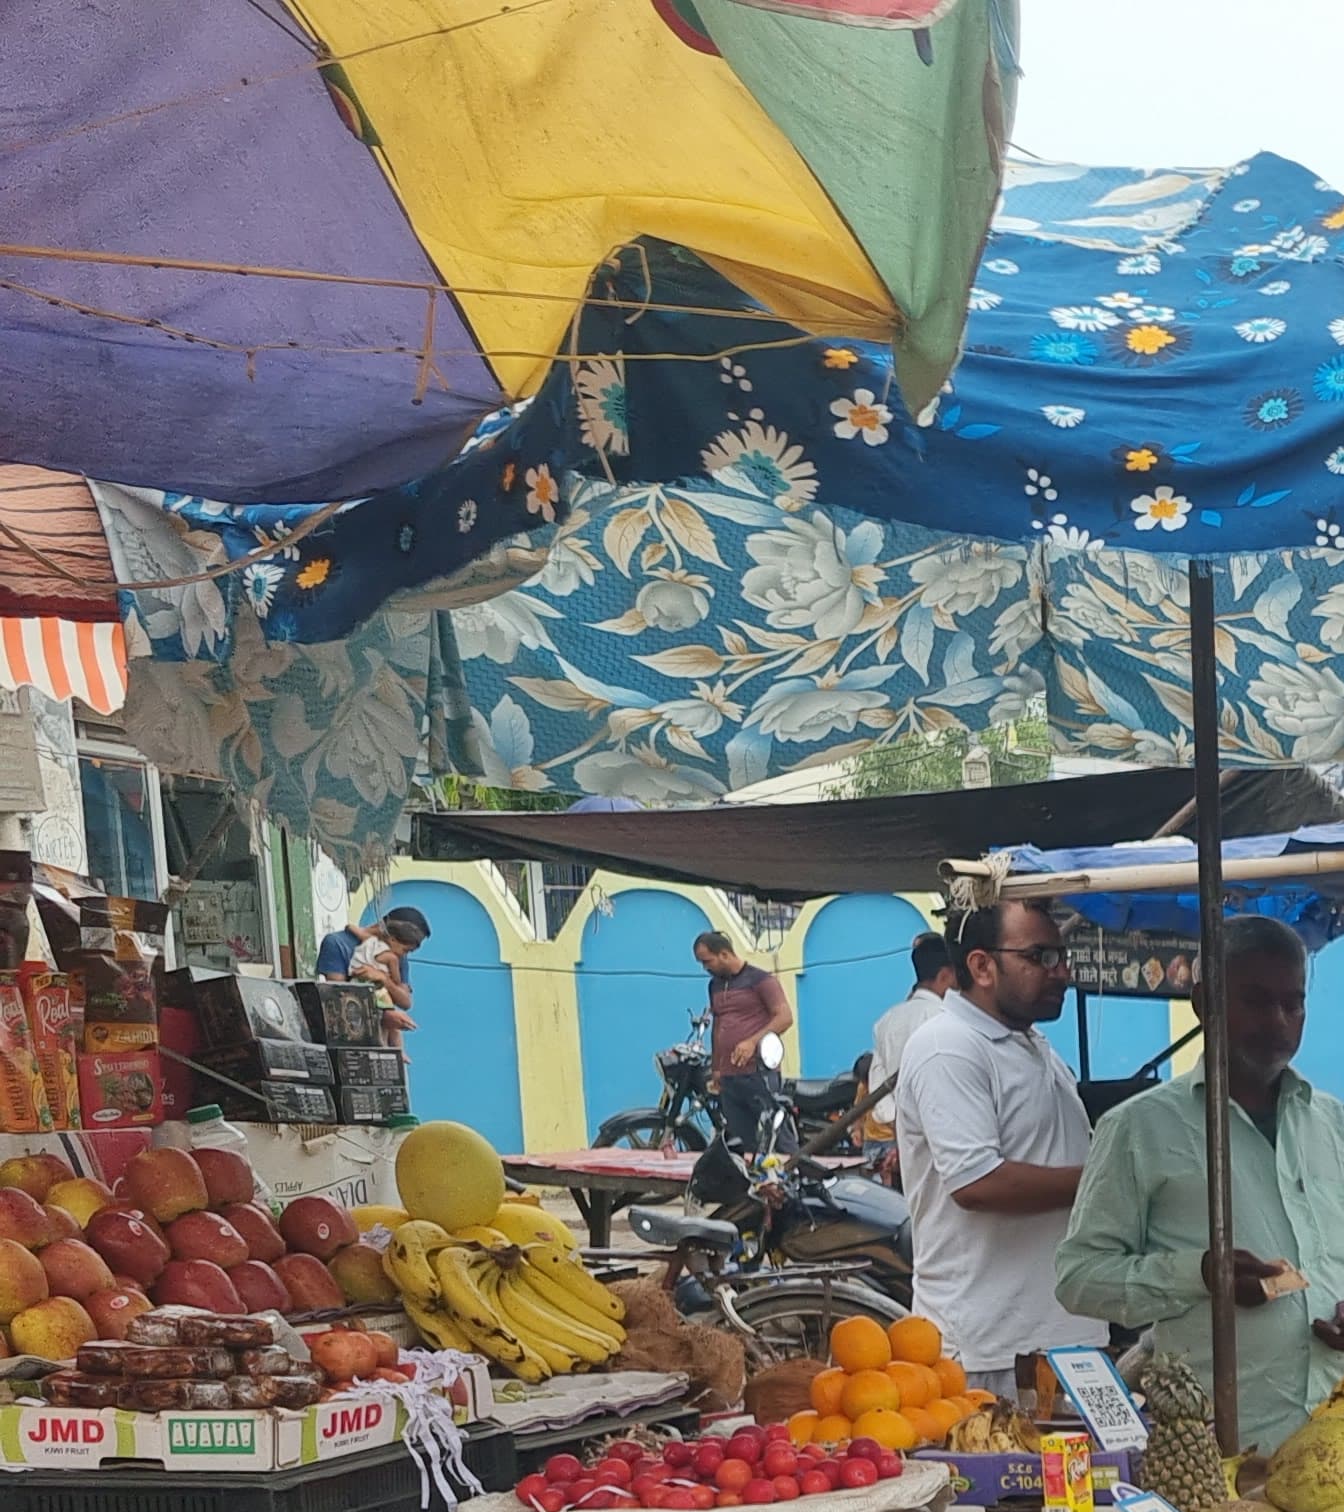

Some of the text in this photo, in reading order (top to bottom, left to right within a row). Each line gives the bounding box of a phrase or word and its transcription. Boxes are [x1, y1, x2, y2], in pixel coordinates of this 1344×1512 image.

[37, 989, 70, 1035] Real
[274, 1180, 304, 1194] APPLES
[28, 1418, 105, 1443] JMD
[322, 1403, 382, 1439] JMD
[44, 1447, 90, 1455] KIWI FRUIT
[1069, 1449, 1091, 1481] Real
[1001, 1475, 1043, 1490] C-104
